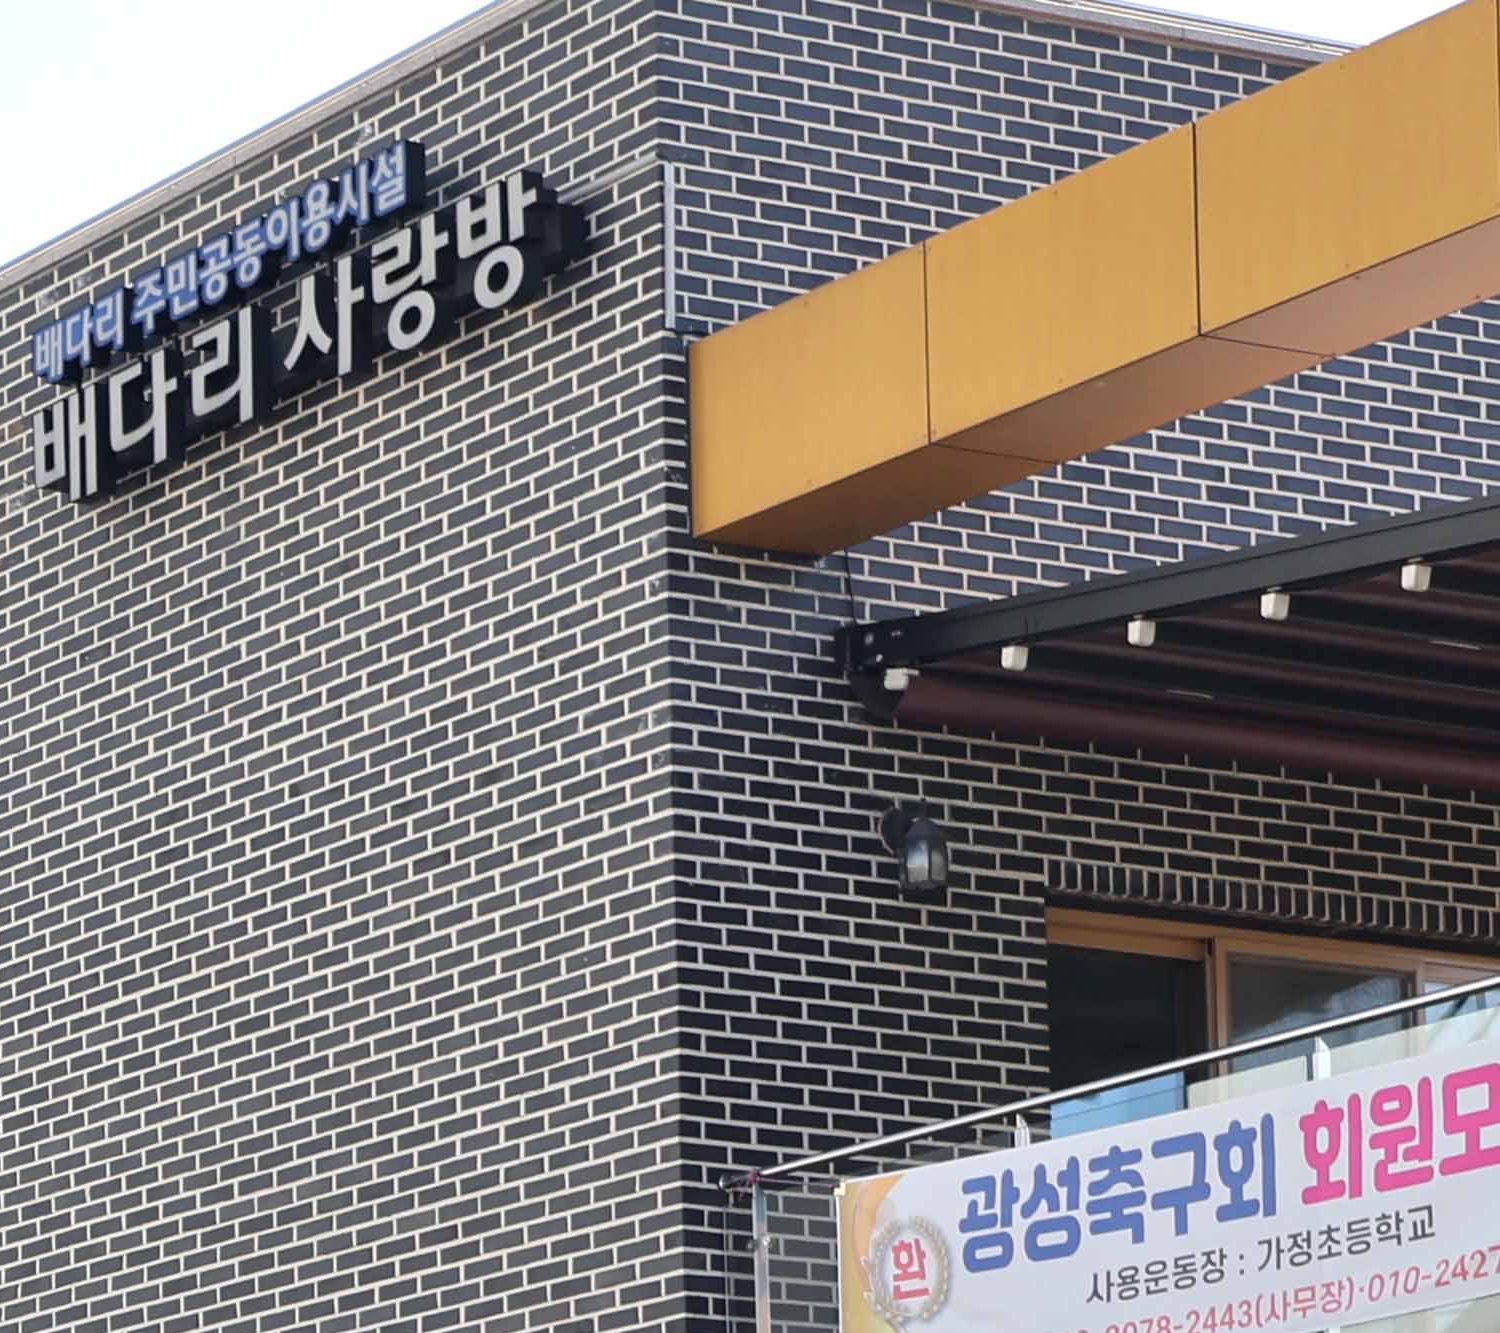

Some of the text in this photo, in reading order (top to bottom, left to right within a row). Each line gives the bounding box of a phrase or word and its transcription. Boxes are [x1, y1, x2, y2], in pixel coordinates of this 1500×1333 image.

[33, 145, 407, 379] 배다리 주민공동이용시설
[33, 173, 537, 501] 배다리 사랑방
[959, 1062, 1500, 1273] 광성축구회 회원모
[1086, 1248, 1227, 1304] 사용운동장
[1257, 1204, 1435, 1273] 가정초등학교
